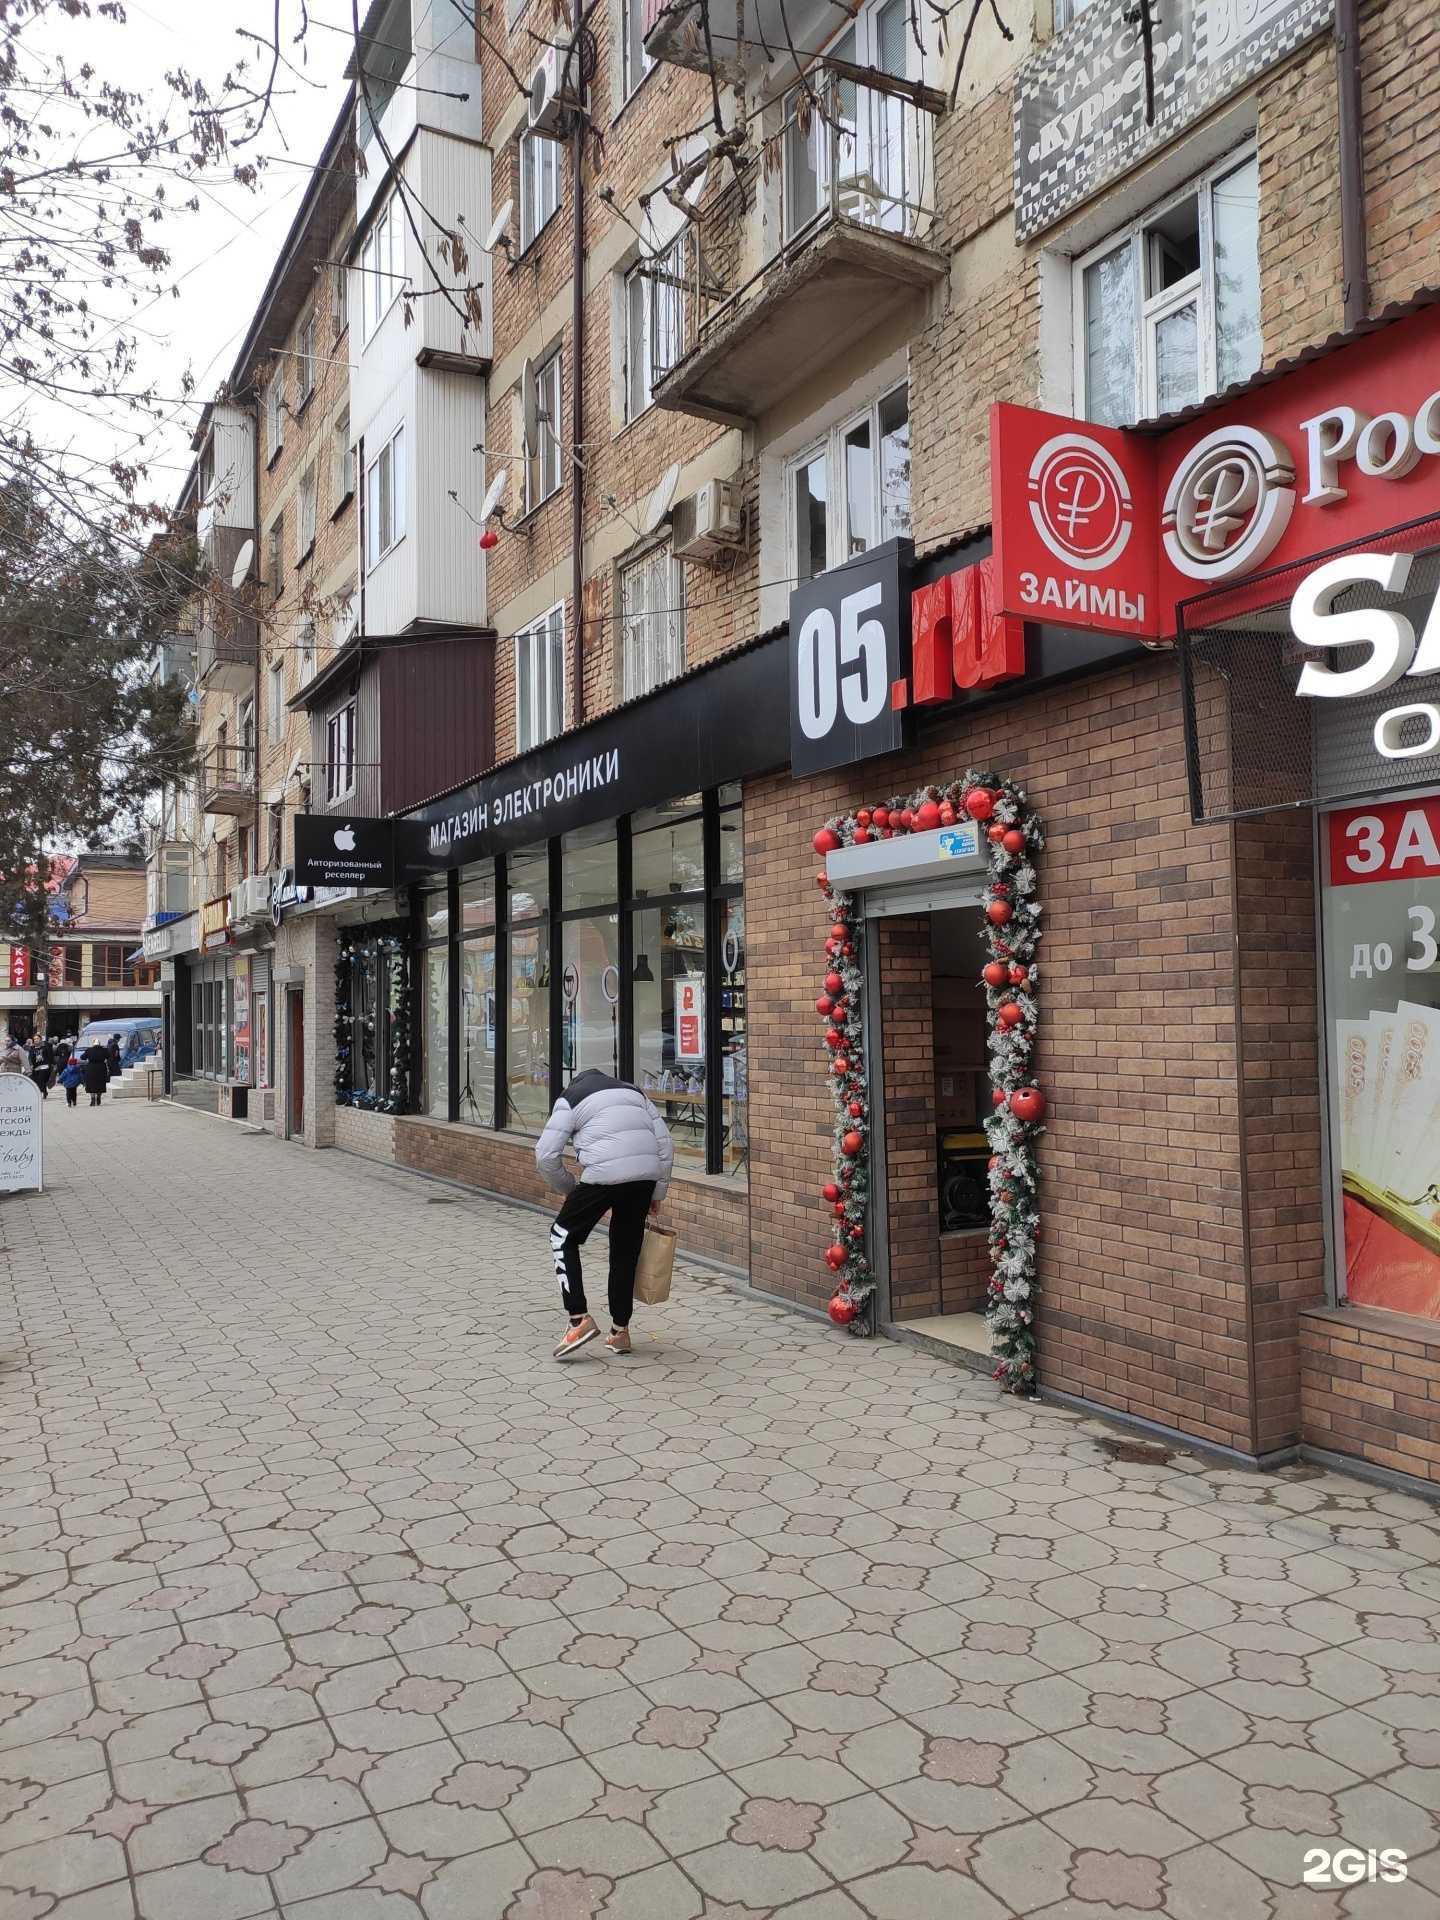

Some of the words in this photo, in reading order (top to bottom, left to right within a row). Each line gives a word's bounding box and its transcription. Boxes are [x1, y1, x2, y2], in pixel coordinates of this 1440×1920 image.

[1022, 182, 1070, 222] Пусть
[1019, 571, 1145, 623] ЗАЙМЫ
[431, 803, 488, 849] МАГАЗИН
[493, 748, 619, 826] ЭЛЕКТРОНИКИ
[307, 858, 382, 869] Авторизованный
[1345, 809, 1440, 874] ЗА
[325, 871, 366, 880] реселлер
[1350, 942, 1393, 979] до
[1406, 904, 1438, 971] 3
[14, 946, 25, 986] КАФЕ
